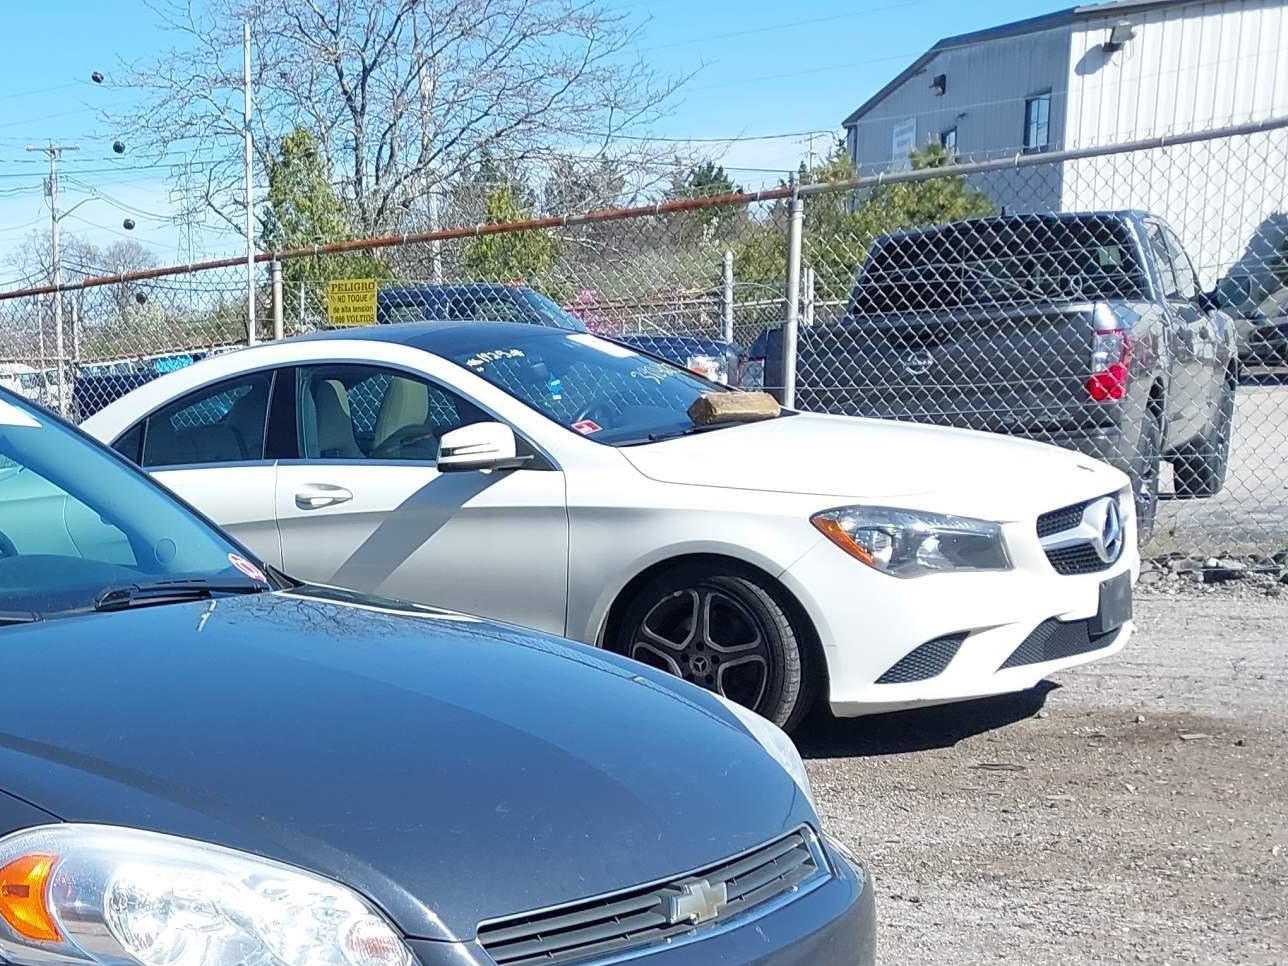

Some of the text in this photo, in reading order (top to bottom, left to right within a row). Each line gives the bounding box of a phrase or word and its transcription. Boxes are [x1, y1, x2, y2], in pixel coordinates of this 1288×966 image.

[331, 282, 375, 292] PELIGRO
[337, 294, 368, 303] NO TOQUE
[346, 314, 374, 323] VOLTIOS
